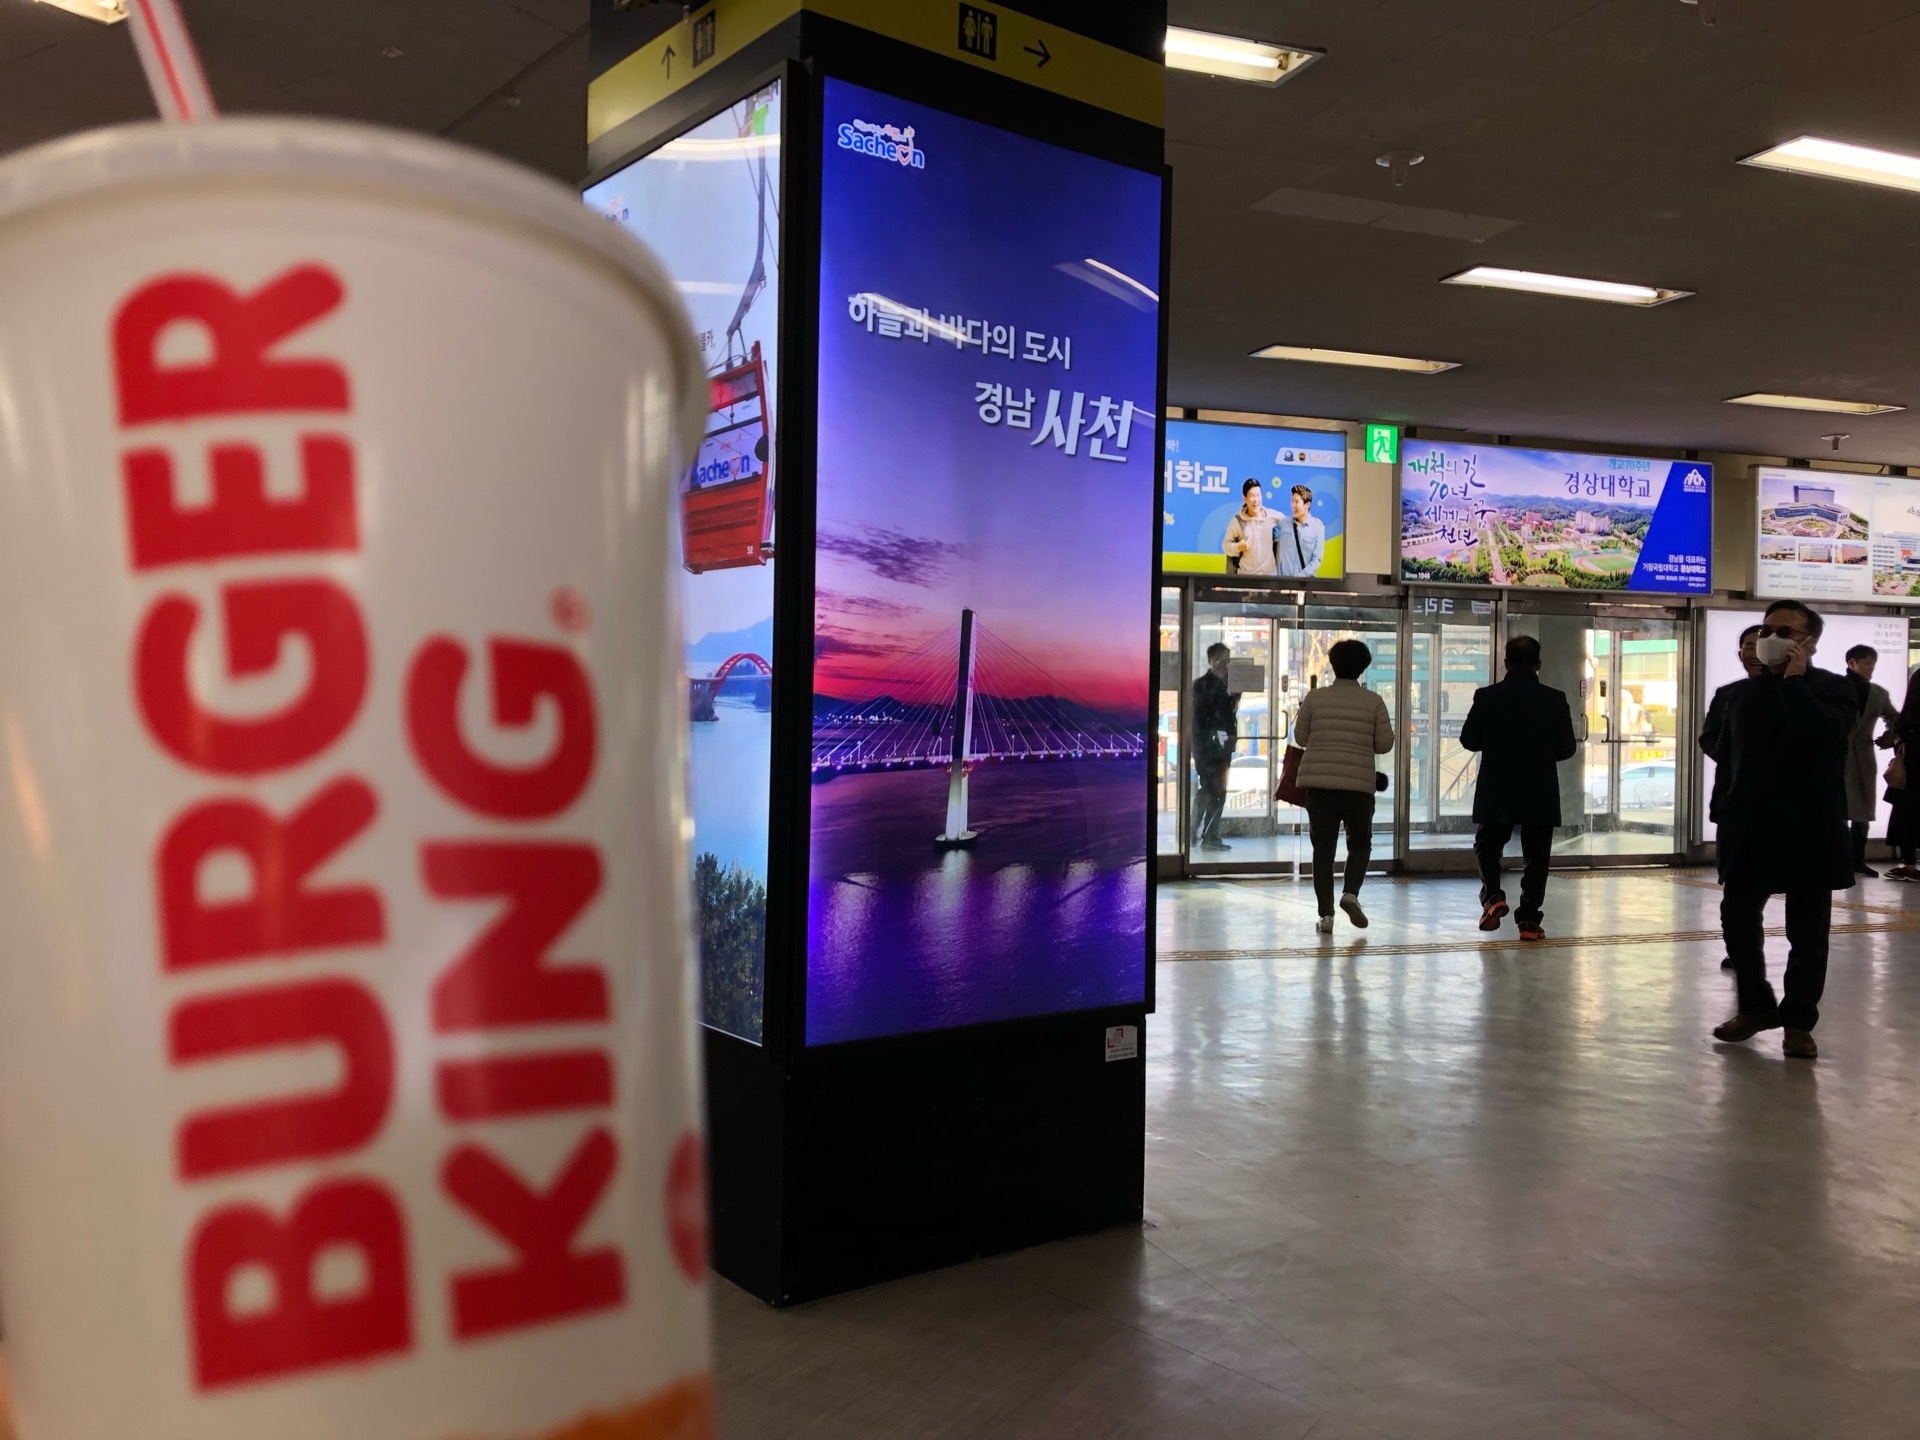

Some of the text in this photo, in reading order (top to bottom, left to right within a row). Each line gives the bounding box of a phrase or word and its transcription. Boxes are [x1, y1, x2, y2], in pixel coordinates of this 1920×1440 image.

[837, 123, 926, 169] Sacheon
[1022, 331, 1072, 371] 도시
[974, 381, 1135, 463] 경남 사천
[1407, 450, 1486, 488] 개척의 길
[1563, 470, 1652, 498] 경상대학교
[1608, 457, 1651, 473] 개교70주년
[1428, 479, 1473, 503] 70년
[1424, 505, 1470, 523] 세계의
[1435, 524, 1479, 547] 천년
[107, 262, 416, 1398] BURGER
[401, 630, 629, 1346] KING
